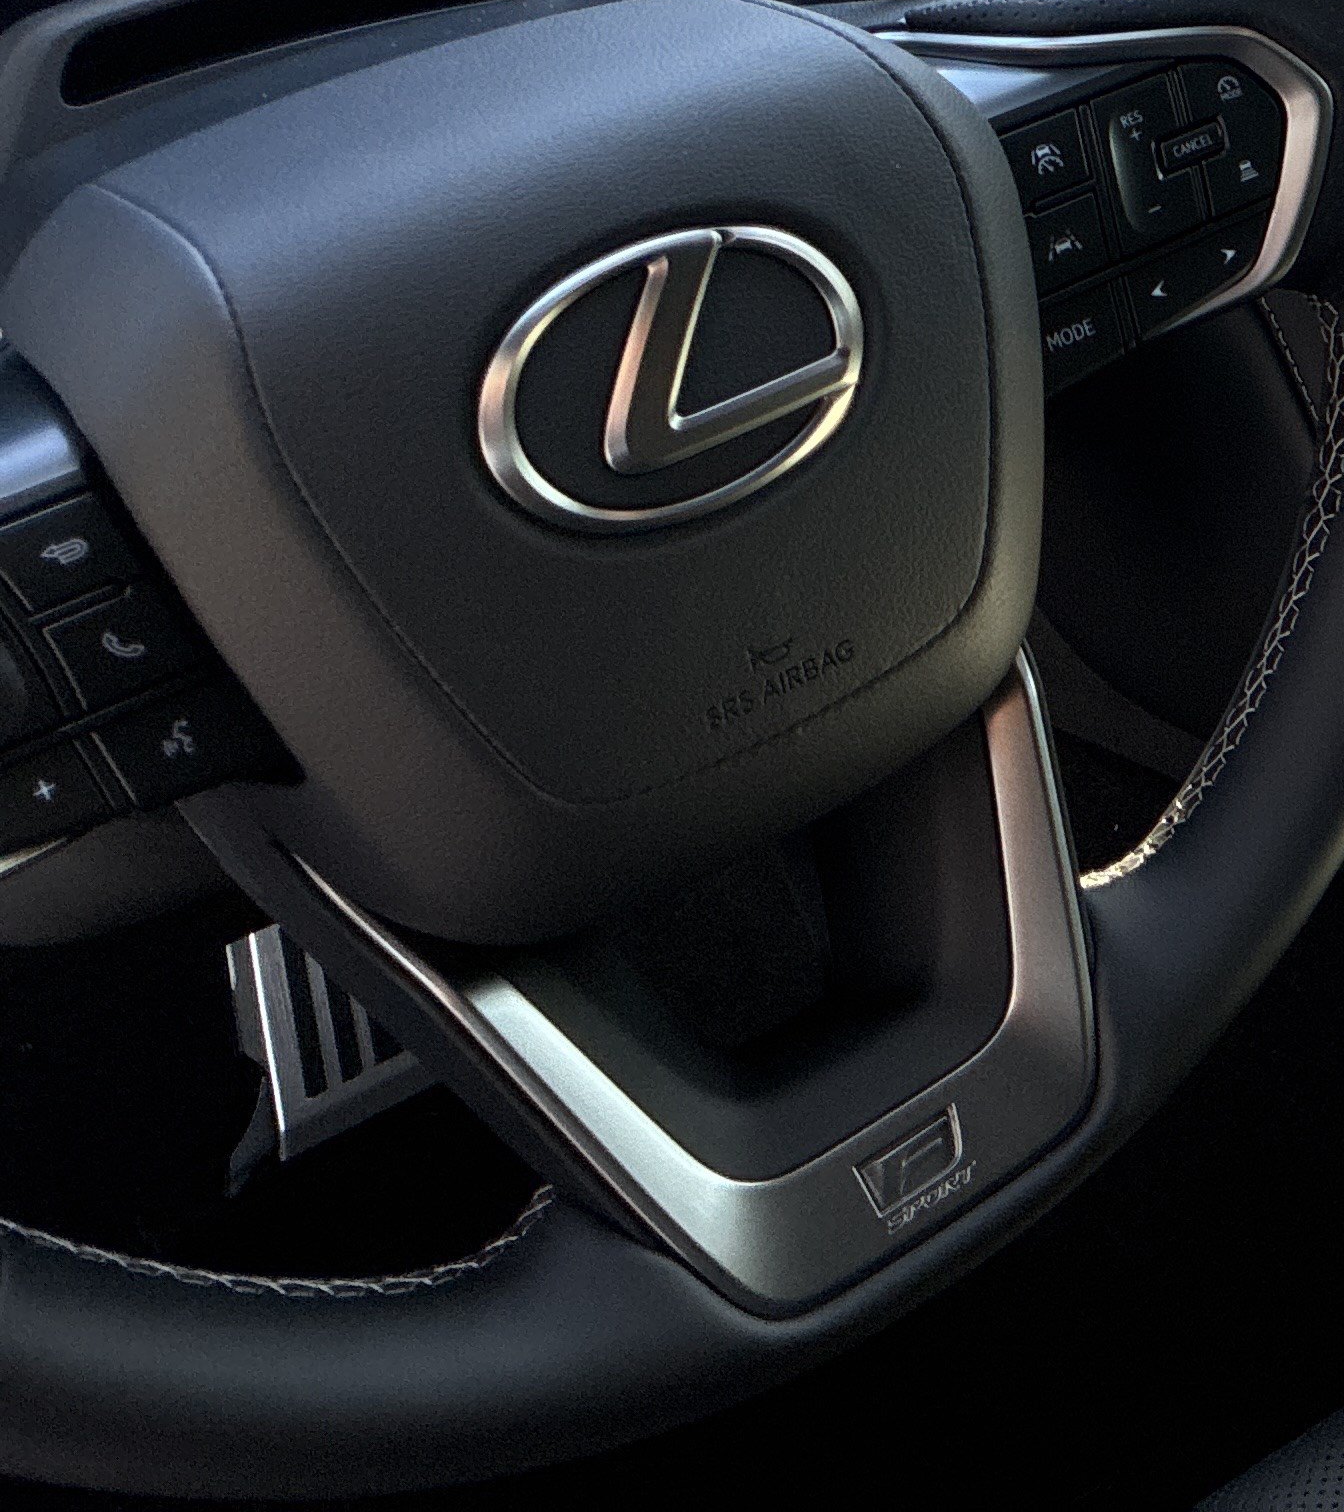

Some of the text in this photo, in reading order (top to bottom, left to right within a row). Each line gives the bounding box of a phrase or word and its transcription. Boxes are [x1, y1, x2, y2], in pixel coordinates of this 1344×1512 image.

[1119, 109, 1143, 129] RES
[1172, 133, 1214, 159] CANCEL
[1045, 318, 1097, 352] MODE
[705, 638, 856, 731] SRS AIRBAG
